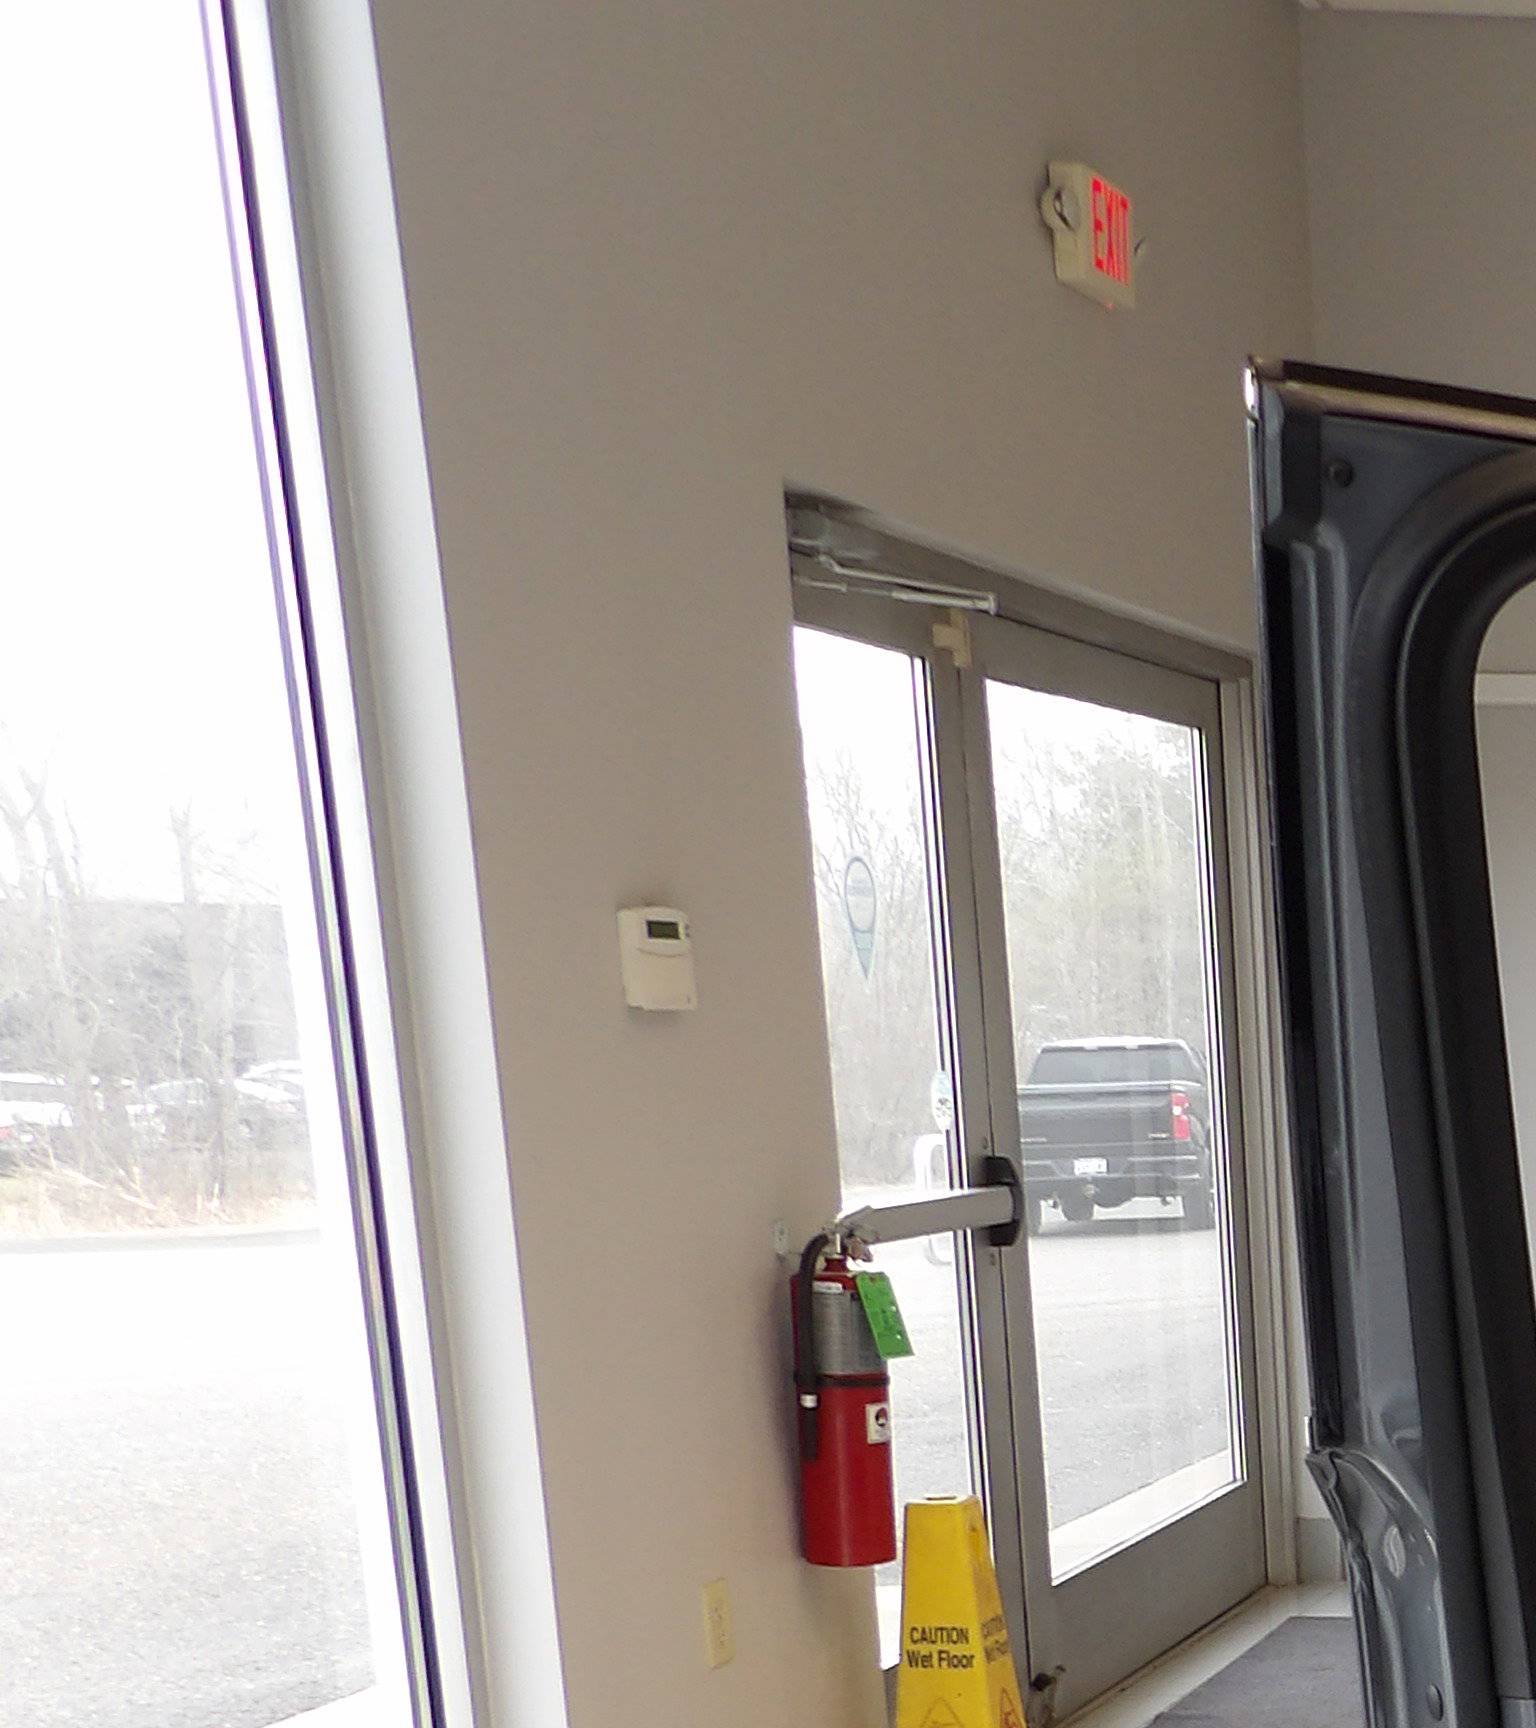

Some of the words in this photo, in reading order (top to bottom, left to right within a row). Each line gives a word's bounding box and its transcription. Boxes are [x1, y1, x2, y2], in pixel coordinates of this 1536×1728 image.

[909, 1626, 970, 1645] CAUTION
[906, 1649, 934, 1669] Wet
[937, 1649, 976, 1669] Floor
